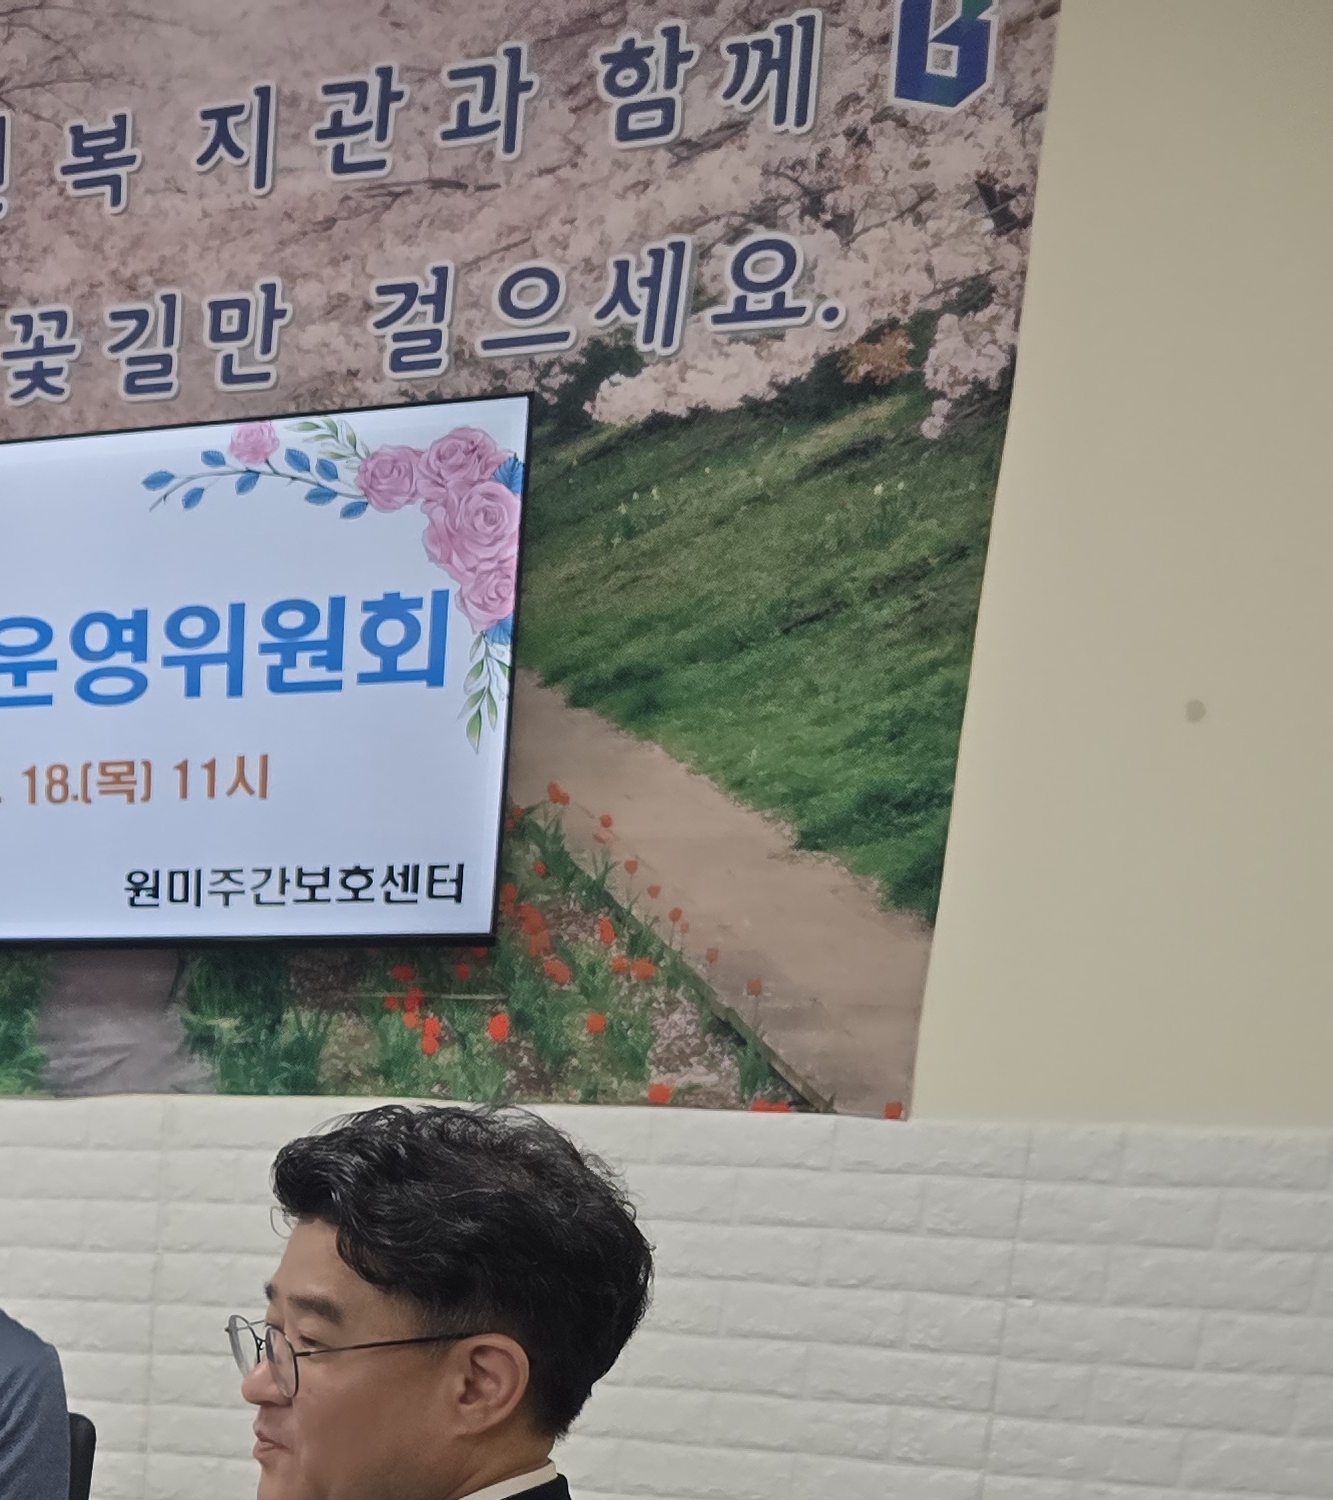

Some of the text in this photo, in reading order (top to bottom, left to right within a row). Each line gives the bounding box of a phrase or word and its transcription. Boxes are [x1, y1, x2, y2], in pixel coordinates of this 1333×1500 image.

[595, 13, 821, 148] 함께
[0, 230, 846, 400] 꽃길만 걸으세요.
[174, 753, 270, 801] 11시
[124, 863, 466, 909] 원미주간보호센터
